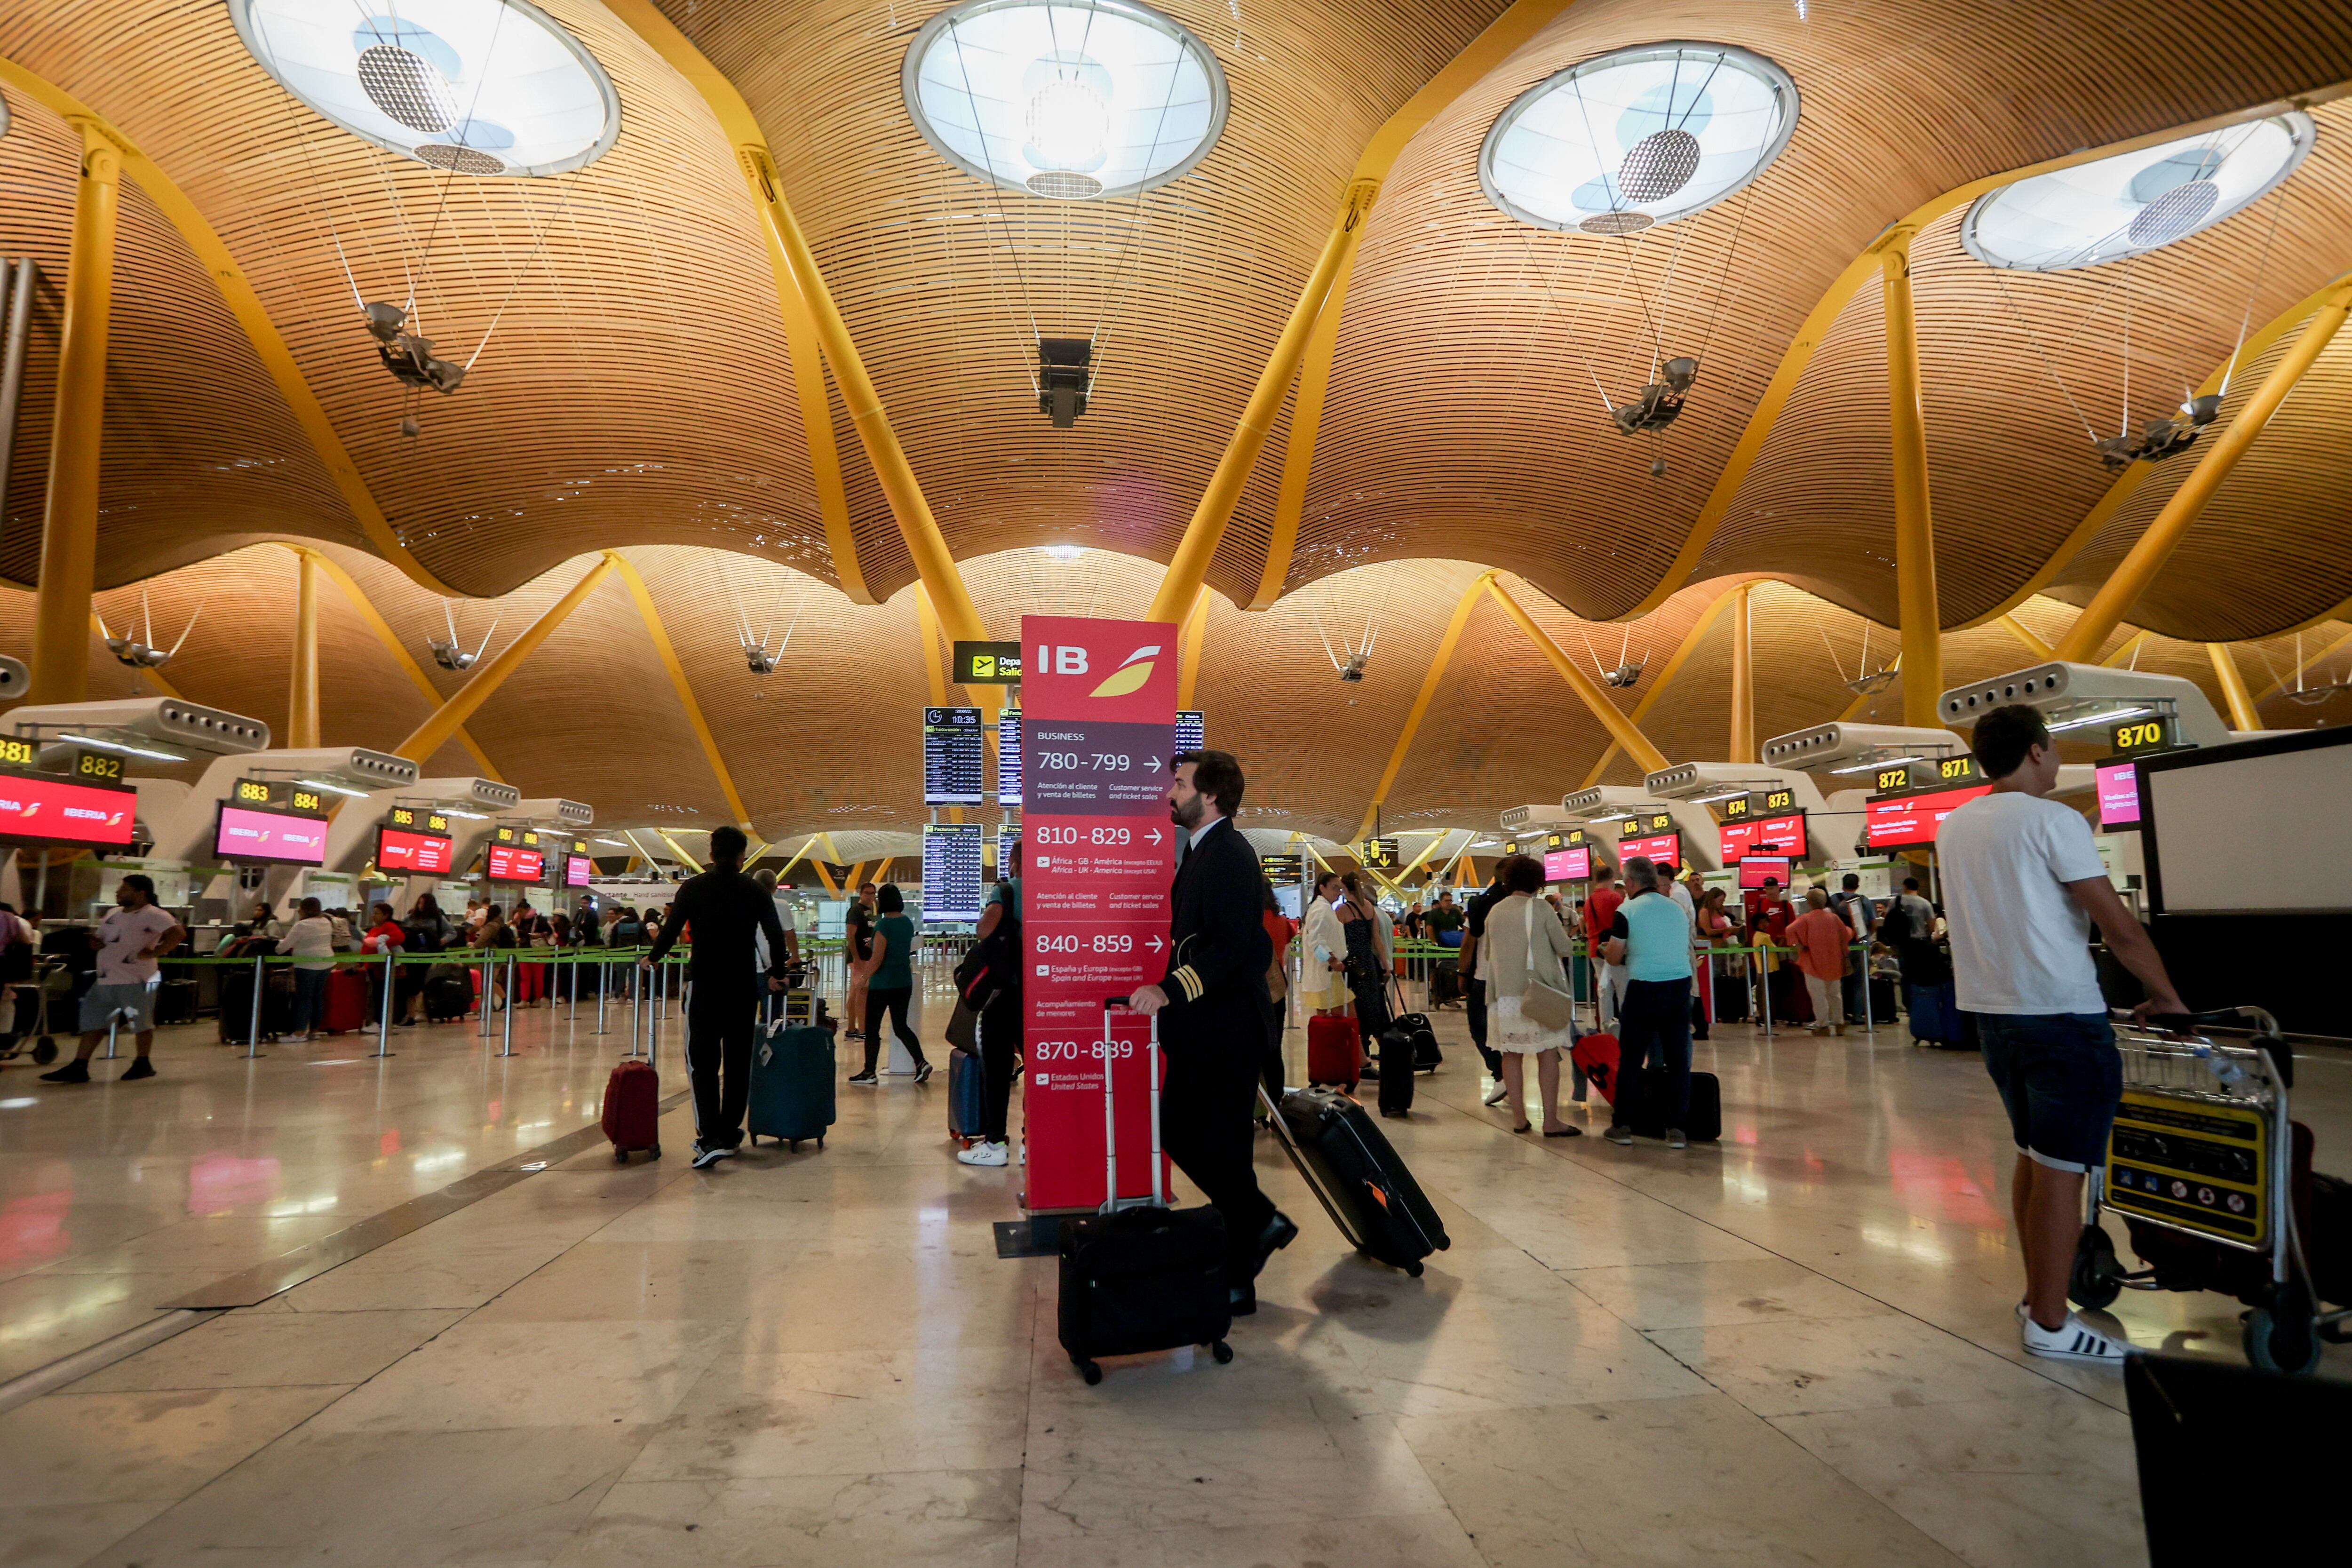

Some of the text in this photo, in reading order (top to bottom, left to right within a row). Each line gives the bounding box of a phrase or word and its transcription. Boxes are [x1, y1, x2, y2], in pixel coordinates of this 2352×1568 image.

[1038, 645, 1089, 675] IB
[1038, 732, 1084, 741] BUSINESS
[2117, 723, 2161, 748] 870
[81, 756, 120, 778] 882
[1941, 758, 1971, 778] 871
[1879, 770, 1906, 788] 872
[240, 783, 269, 801] 883
[294, 792, 318, 810] 884
[1768, 792, 1789, 808] 873
[64, 807, 107, 820] IBERIA
[1728, 800, 1747, 815] 874
[394, 810, 413, 824] 885
[429, 816, 446, 830] 886
[1653, 815, 1668, 828] 875
[229, 827, 259, 837] IBERIA
[1624, 821, 1638, 833] 876
[283, 834, 310, 843] IBERIA
[1052, 856, 1073, 865] África
[1051, 965, 1076, 973] España
[1083, 965, 1108, 973] Europa
